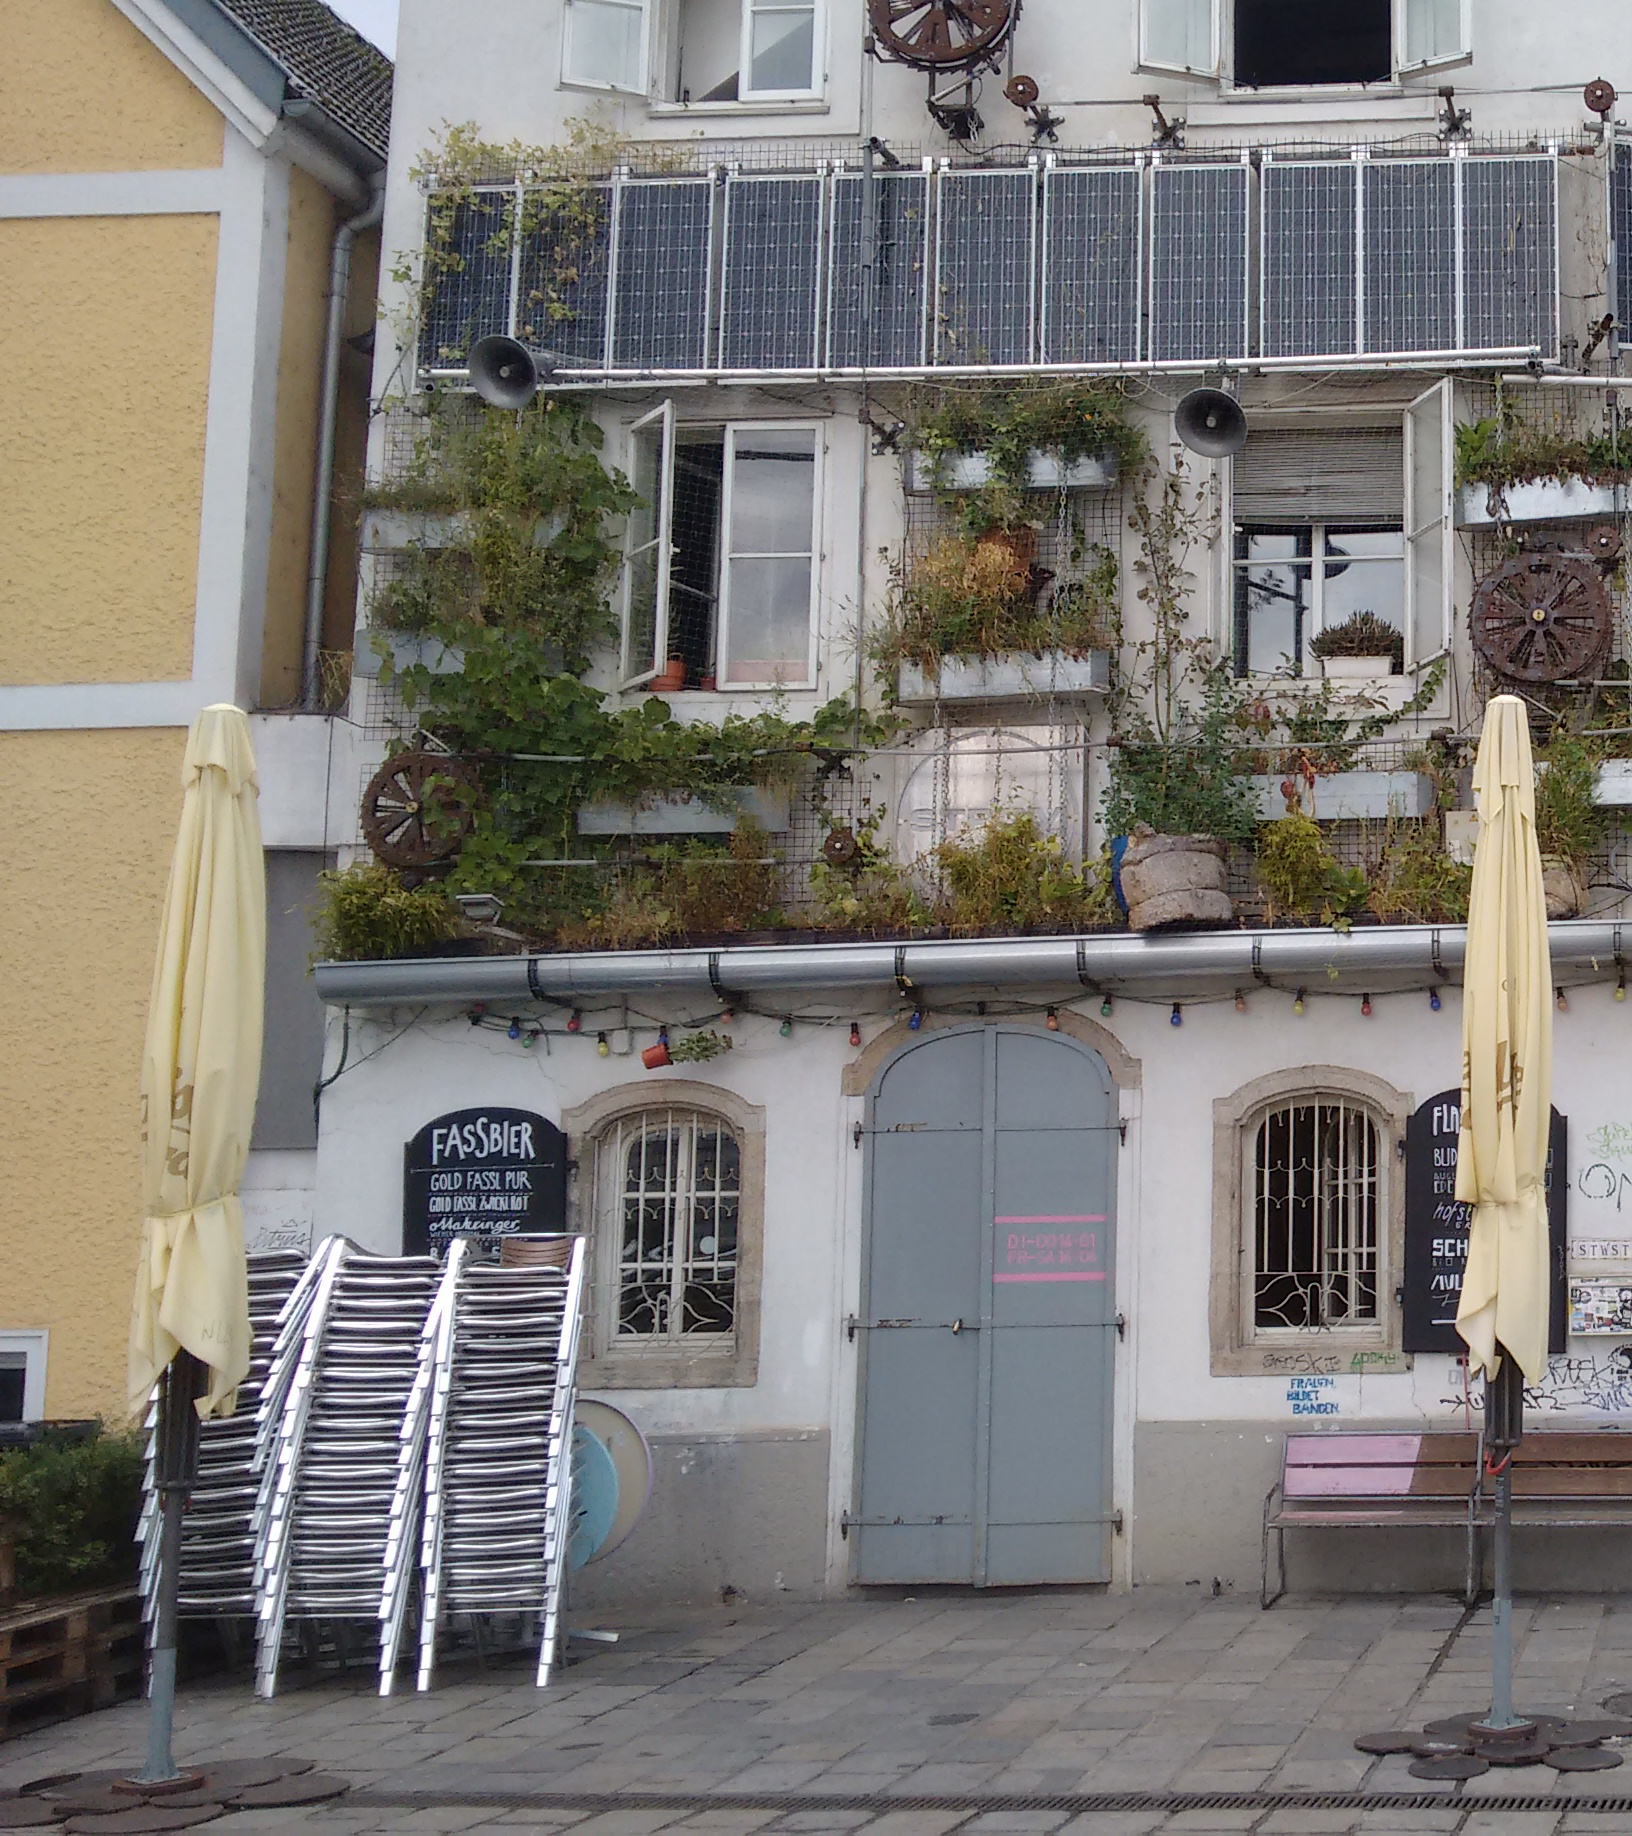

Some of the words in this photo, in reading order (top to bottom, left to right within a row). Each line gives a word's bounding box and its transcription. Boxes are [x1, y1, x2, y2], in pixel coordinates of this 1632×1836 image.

[431, 1117, 536, 1166] FASSBIER
[430, 1172, 462, 1191] GOLD
[466, 1171, 501, 1191] FASSL
[505, 1170, 532, 1190] PUR
[429, 1197, 451, 1213] GOLD
[511, 1195, 529, 1211] ROT
[1579, 1244, 1630, 1257] STWST
